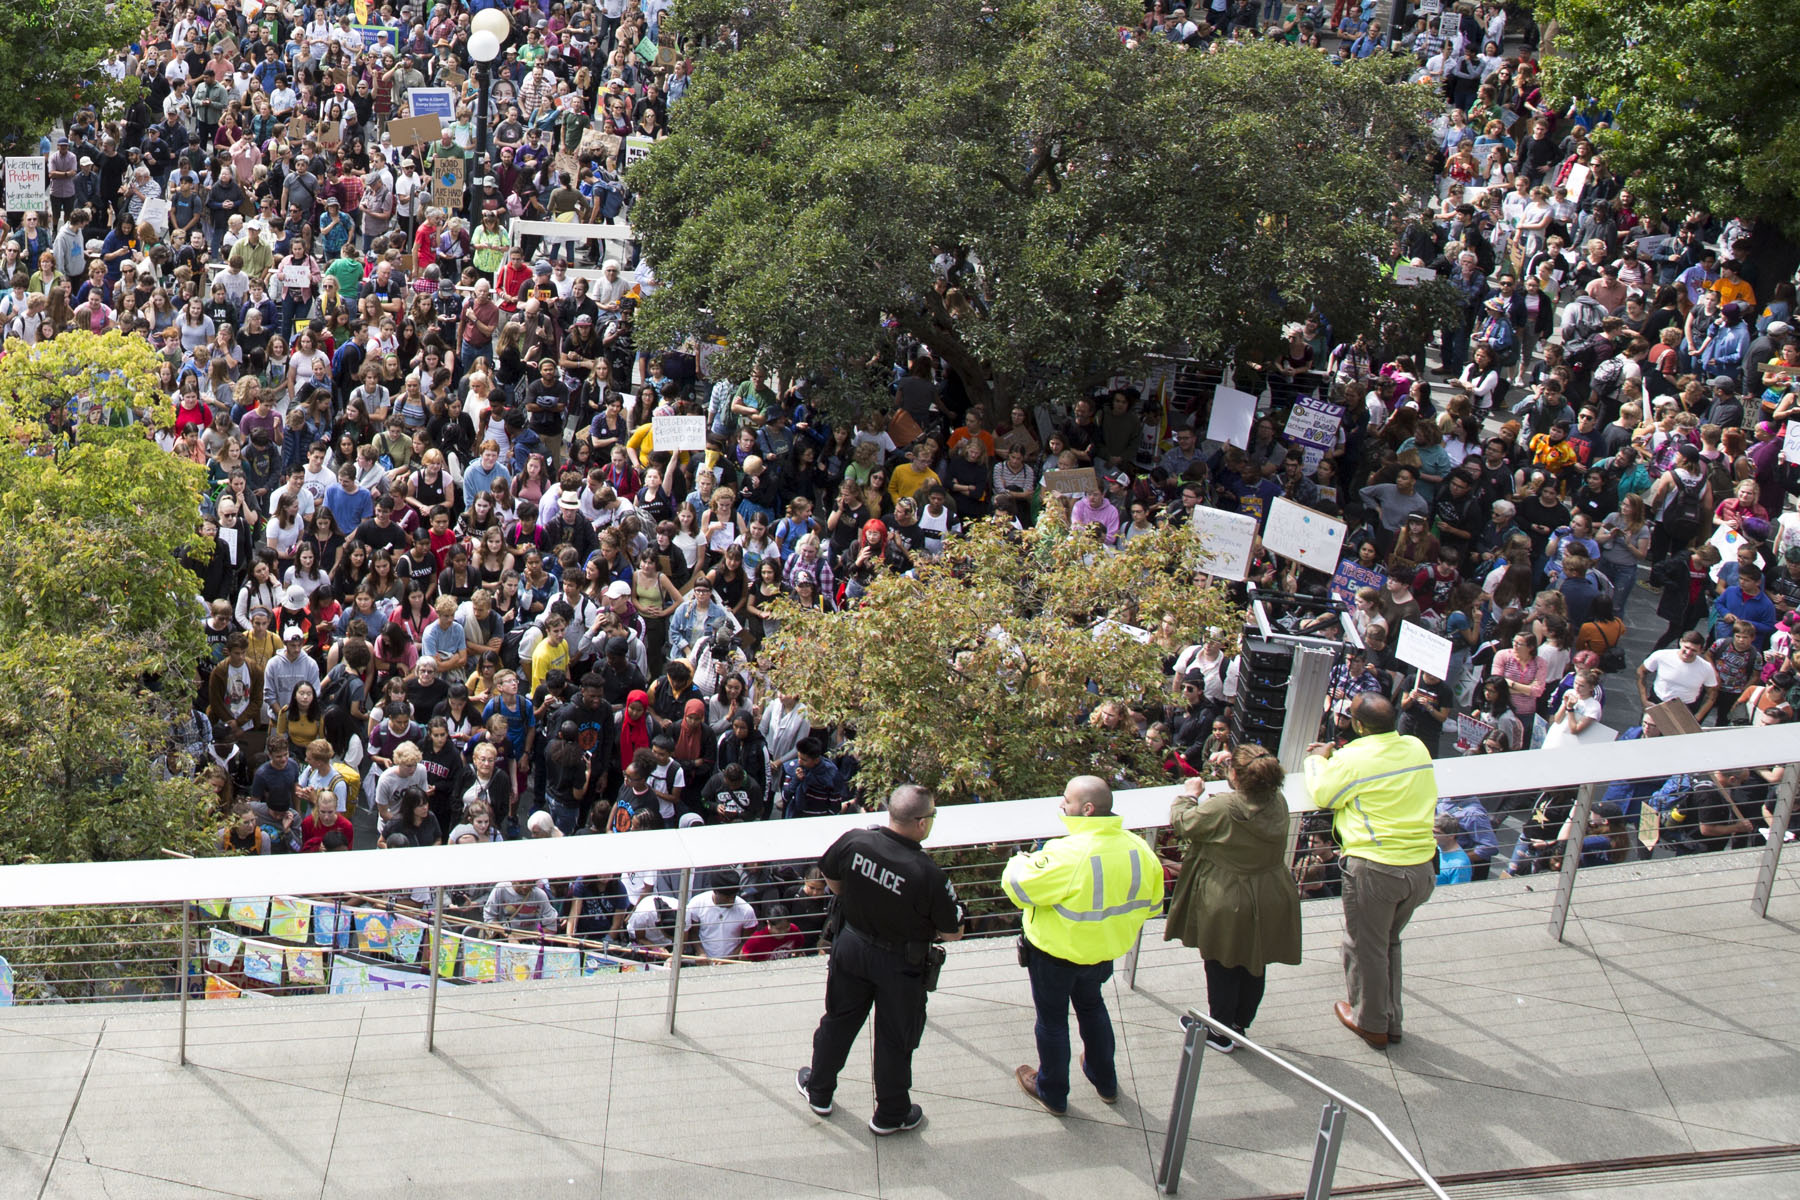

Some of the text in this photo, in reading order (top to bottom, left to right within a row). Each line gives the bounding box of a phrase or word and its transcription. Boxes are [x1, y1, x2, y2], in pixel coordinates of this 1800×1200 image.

[7, 160, 18, 170] We
[29, 159, 43, 170] the
[440, 160, 459, 168] GOOD
[8, 169, 40, 183] Problem
[435, 168, 463, 179] PLANETS
[19, 183, 31, 191] but
[436, 188, 463, 198] ARE HARD
[8, 199, 43, 210] Solution
[437, 197, 461, 206] TO FIND
[1299, 396, 1342, 416] SEIU
[1304, 428, 1337, 446] NOW
[1342, 560, 1383, 588] THERE
[851, 852, 906, 896] POLICE
